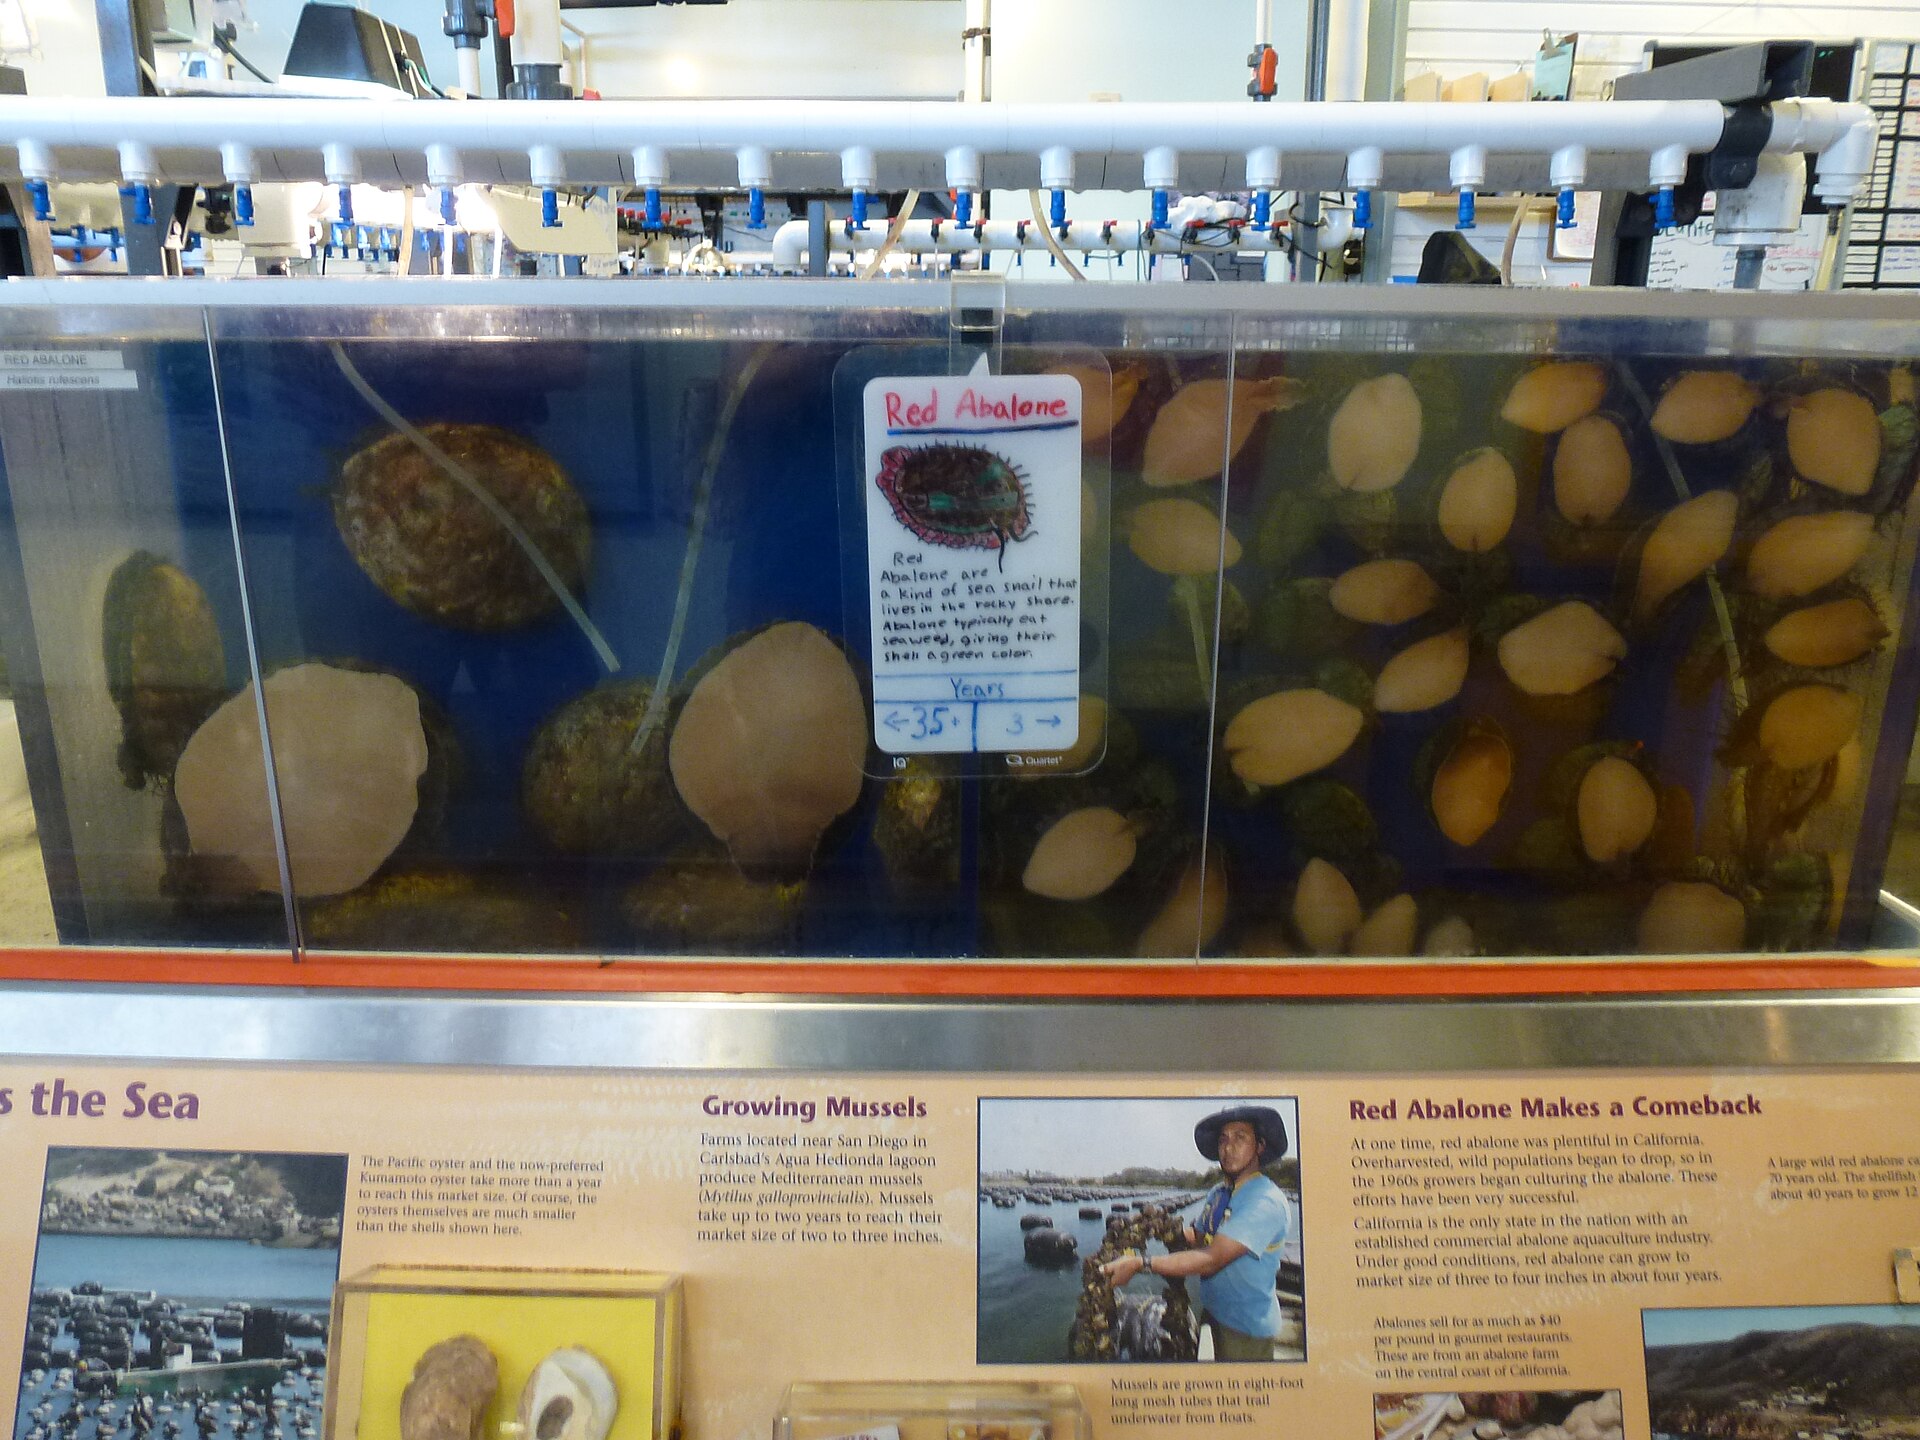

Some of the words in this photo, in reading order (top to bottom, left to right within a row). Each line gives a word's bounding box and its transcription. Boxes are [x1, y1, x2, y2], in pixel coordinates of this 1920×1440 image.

[4, 355, 29, 365] RED
[32, 354, 87, 365] ABALONE
[7, 375, 46, 385] Haliotis
[49, 375, 100, 385] rufescens
[885, 387, 938, 427] Red
[955, 387, 1068, 422] Abalone
[893, 551, 923, 566] Red
[880, 568, 948, 584] Abalone
[961, 567, 989, 580] are
[880, 588, 890, 599] a
[899, 587, 933, 600] kind
[941, 582, 957, 597] of
[968, 583, 996, 596] sea
[1004, 575, 1043, 593] snail
[1048, 577, 1078, 589] that
[882, 603, 916, 615] lives
[920, 602, 933, 613] in
[941, 602, 966, 612] the
[975, 599, 1016, 611] rocky
[883, 619, 947, 632] Abalone
[954, 615, 1014, 630] typically
[1019, 614, 1048, 625] eat
[882, 632, 955, 647] seaweed,
[960, 632, 1009, 647] giving
[1016, 631, 1056, 643] their
[884, 651, 919, 662] shell
[950, 677, 1004, 700] Years
[1006, 712, 1024, 735] 3
[31, 1078, 106, 1117] the
[122, 1081, 200, 1119] Sea
[1349, 1098, 1396, 1120] Red
[1406, 1097, 1511, 1119] Abalone
[1520, 1096, 1600, 1118] Makes
[1609, 1101, 1623, 1117] a
[1632, 1094, 1761, 1116] Comeback
[702, 1094, 816, 1122] Growing
[826, 1096, 926, 1117] Mussels
[701, 1132, 741, 1146] Farms
[747, 1132, 796, 1147] located
[802, 1136, 832, 1147] near
[837, 1133, 862, 1147] San
[868, 1134, 908, 1151] Diego
[913, 1134, 926, 1148] in
[1350, 1138, 1365, 1150] At
[1370, 1140, 1396, 1150] one
[1400, 1137, 1434, 1151] time,
[1440, 1137, 1461, 1149] red
[1466, 1136, 1519, 1149] abalone
[1524, 1138, 1548, 1148] was
[1553, 1134, 1610, 1150] plentiful
[1615, 1134, 1628, 1147] in
[1633, 1133, 1702, 1146] California.
[363, 1156, 383, 1168] The
[387, 1157, 424, 1168] Pacific
[429, 1157, 464, 1172] oyster
[469, 1158, 491, 1170] and
[496, 1158, 515, 1170] the
[520, 1159, 603, 1174] now-preferred
[700, 1151, 770, 1165] Carlsbad's
[775, 1152, 809, 1169] Agua
[816, 1152, 883, 1166] Hedionda
[889, 1153, 935, 1170] lagoon
[1458, 1155, 1488, 1168] wild
[1492, 1154, 1572, 1170] populations
[1577, 1153, 1617, 1169] began
[1622, 1153, 1636, 1165] to
[1640, 1152, 1675, 1168] drop,
[1680, 1155, 1694, 1164] so
[1699, 1152, 1712, 1164] in
[1768, 1157, 1775, 1168] A
[1779, 1157, 1806, 1170] large
[1810, 1156, 1834, 1167] wild
[1838, 1156, 1856, 1166] red
[1860, 1155, 1904, 1166] abalone
[1907, 1157, 1920, 1165] ca
[360, 1172, 426, 1184] Kumamoto
[430, 1173, 464, 1188] oyster
[470, 1174, 494, 1186] take
[499, 1177, 530, 1186] more
[534, 1175, 561, 1187] than
[566, 1178, 572, 1187] a
[576, 1178, 600, 1190] year
[699, 1170, 756, 1188] produce
[761, 1171, 863, 1185] Mediterranean
[869, 1172, 922, 1186] mussels
[1352, 1175, 1374, 1188] the
[1381, 1174, 1418, 1187] 1960s
[1423, 1177, 1476, 1190] growers
[1480, 1173, 1520, 1189] began
[1524, 1172, 1587, 1188] culturing
[1592, 1172, 1613, 1184] the
[1618, 1171, 1673, 1184] abalone.
[1681, 1170, 1717, 1183] These
[698, 1189, 752, 1206] (Mytilus
[879, 1191, 933, 1204] Mussels
[1352, 1193, 1396, 1206] efforts
[1400, 1193, 1433, 1205] have
[1438, 1192, 1470, 1205] been
[1474, 1195, 1504, 1208] very
[1508, 1192, 1578, 1204] successful.
[356, 1204, 398, 1219] oysters
[402, 1205, 468, 1217] themselves
[472, 1209, 490, 1218] are
[494, 1207, 528, 1219] much
[532, 1207, 574, 1220] smaller
[356, 1220, 383, 1232] than
[388, 1221, 407, 1232] the
[411, 1221, 444, 1233] shells
[448, 1222, 488, 1234] shown
[493, 1223, 521, 1235] here.
[697, 1227, 745, 1241] market
[751, 1227, 776, 1241] size
[781, 1228, 796, 1242] of
[801, 1228, 827, 1242] two
[832, 1228, 846, 1242] to
[852, 1228, 888, 1242] three
[893, 1229, 942, 1243] inches.
[1354, 1235, 1428, 1249] established
[1433, 1234, 1511, 1248] commercial
[1516, 1233, 1568, 1246] abalone
[1572, 1232, 1650, 1249] aquaculture
[1655, 1231, 1712, 1248] industry.
[1375, 1370, 1391, 1379] on
[1394, 1368, 1414, 1378] the
[1417, 1367, 1457, 1378] central
[1461, 1366, 1490, 1377] coast
[1494, 1366, 1506, 1377] of
[1111, 1378, 1158, 1390] Mussels
[1162, 1381, 1180, 1390] are
[1184, 1381, 1223, 1392] grown
[1227, 1378, 1240, 1389] in
[1244, 1377, 1303, 1392] eight-foot
[1111, 1395, 1138, 1410] long
[1143, 1395, 1175, 1406] mesh
[1180, 1395, 1212, 1406] tubes
[1216, 1394, 1240, 1406] that
[1245, 1394, 1269, 1406] trail
[1111, 1412, 1181, 1424] underwater
[1185, 1412, 1214, 1424] from
[1219, 1411, 1255, 1424] floats.
